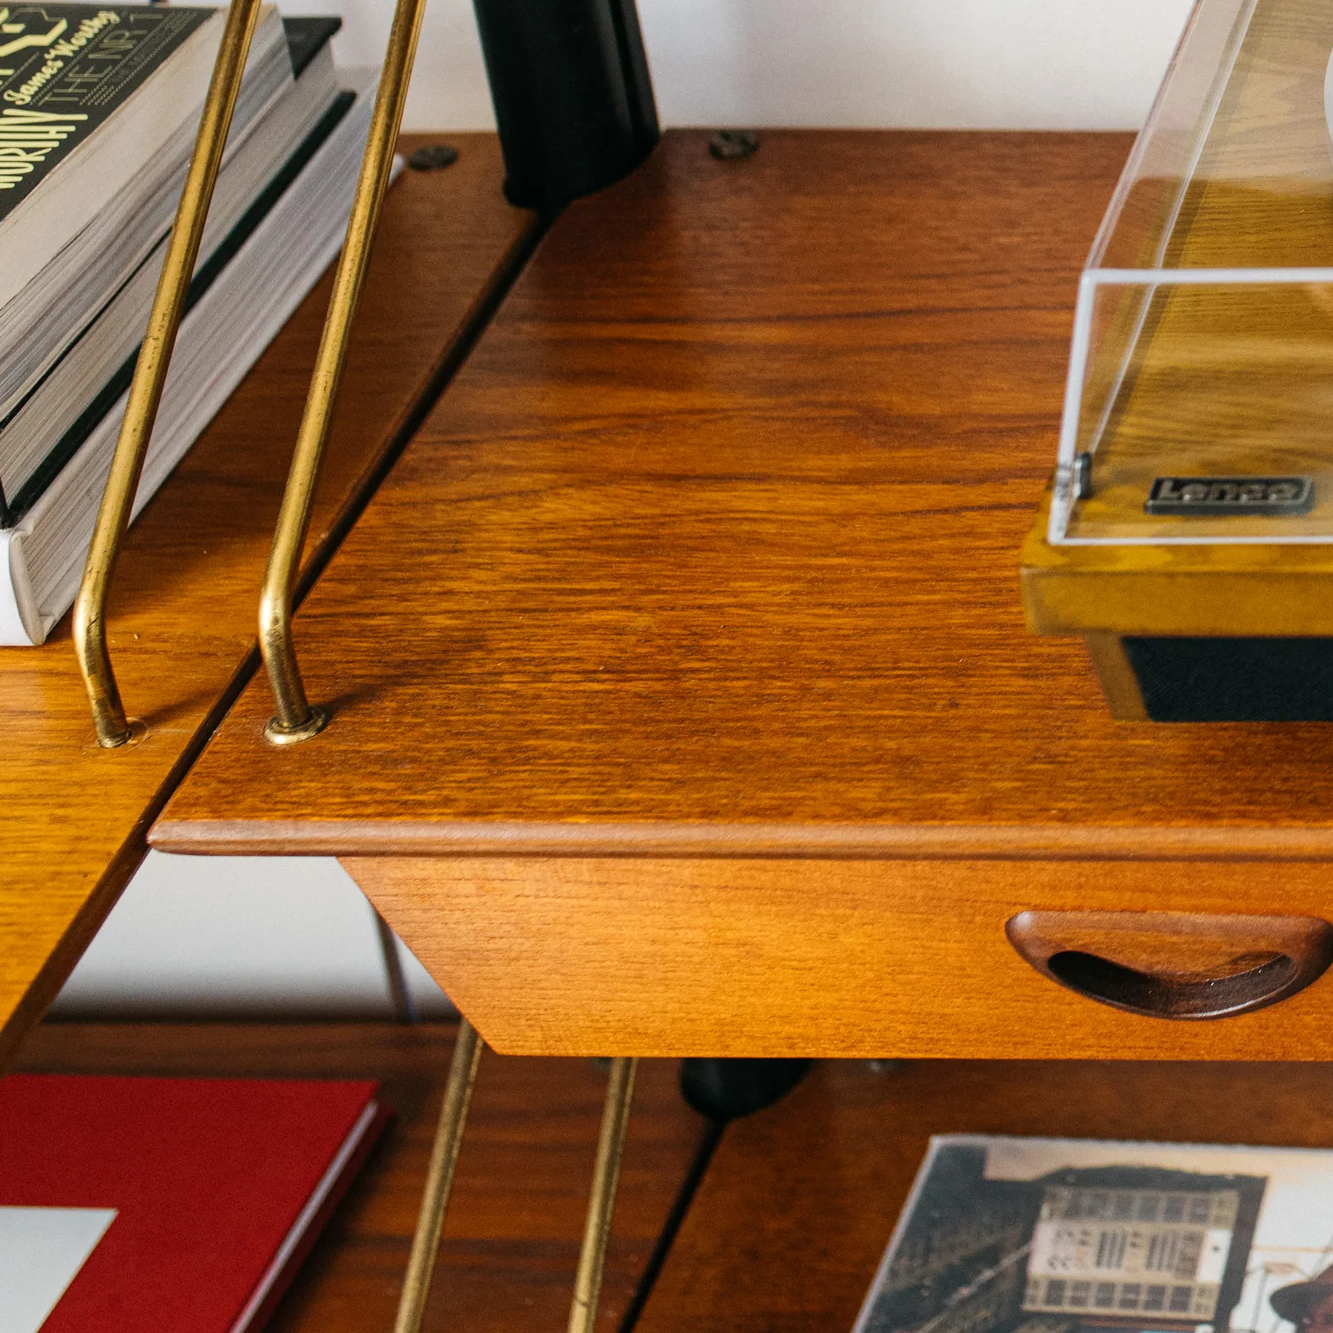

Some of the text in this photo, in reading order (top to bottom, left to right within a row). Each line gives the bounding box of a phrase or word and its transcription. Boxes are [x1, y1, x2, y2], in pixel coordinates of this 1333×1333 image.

[3, 58, 64, 106] James
[44, 10, 121, 60] Worthy
[38, 64, 114, 107] THE
[0, 108, 88, 189] RTHY
